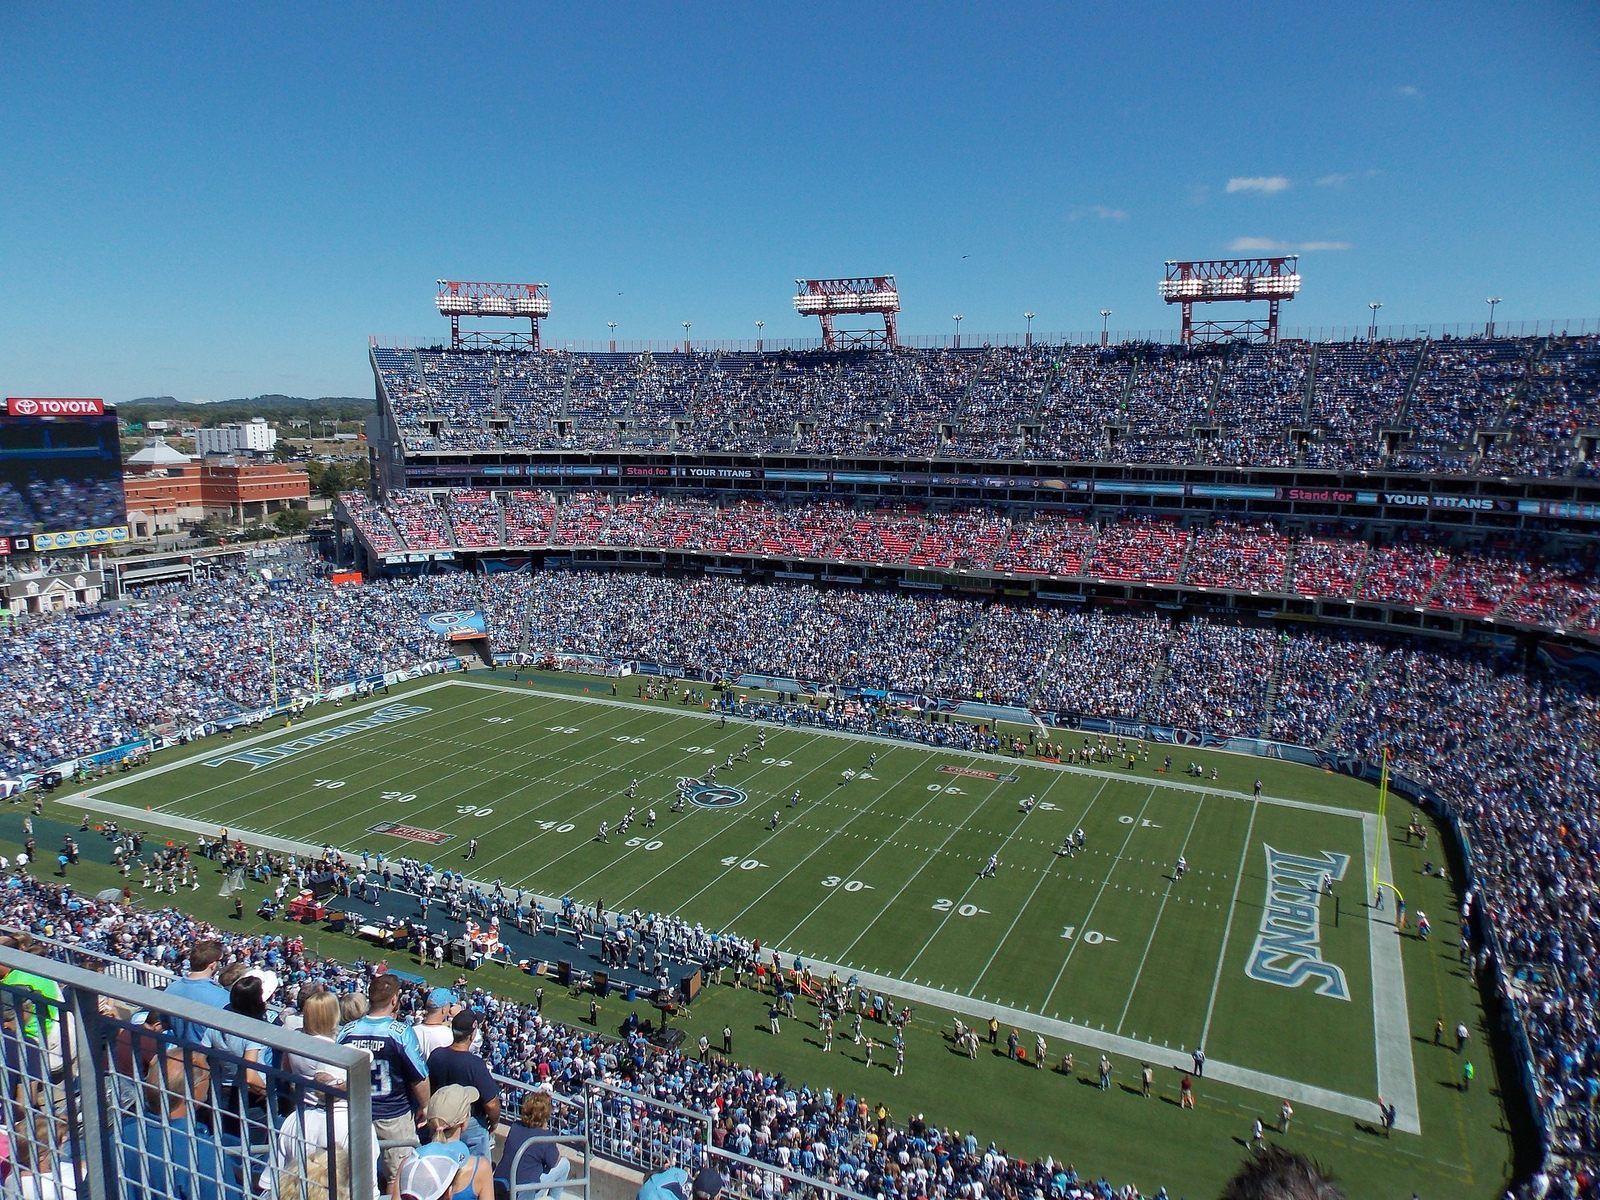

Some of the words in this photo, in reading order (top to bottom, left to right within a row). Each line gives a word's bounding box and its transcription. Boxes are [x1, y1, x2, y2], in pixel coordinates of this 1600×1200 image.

[40, 401, 99, 413] TOYOTA
[626, 467, 652, 475] Stand
[654, 467, 669, 475] for
[689, 468, 716, 476] YOUR
[718, 469, 751, 478] TITANS
[1288, 489, 1329, 501] Stand
[1332, 490, 1353, 502] for
[1384, 493, 1429, 506] YOUR
[1433, 496, 1494, 510] TITANS
[313, 778, 347, 790] 10
[380, 791, 417, 803] 20
[456, 804, 494, 818] 30
[539, 820, 576, 834] 40
[624, 836, 664, 851] 50
[720, 855, 760, 870] 40
[820, 875, 864, 892] 30
[931, 898, 979, 917] 20
[1059, 926, 1104, 945] 10
